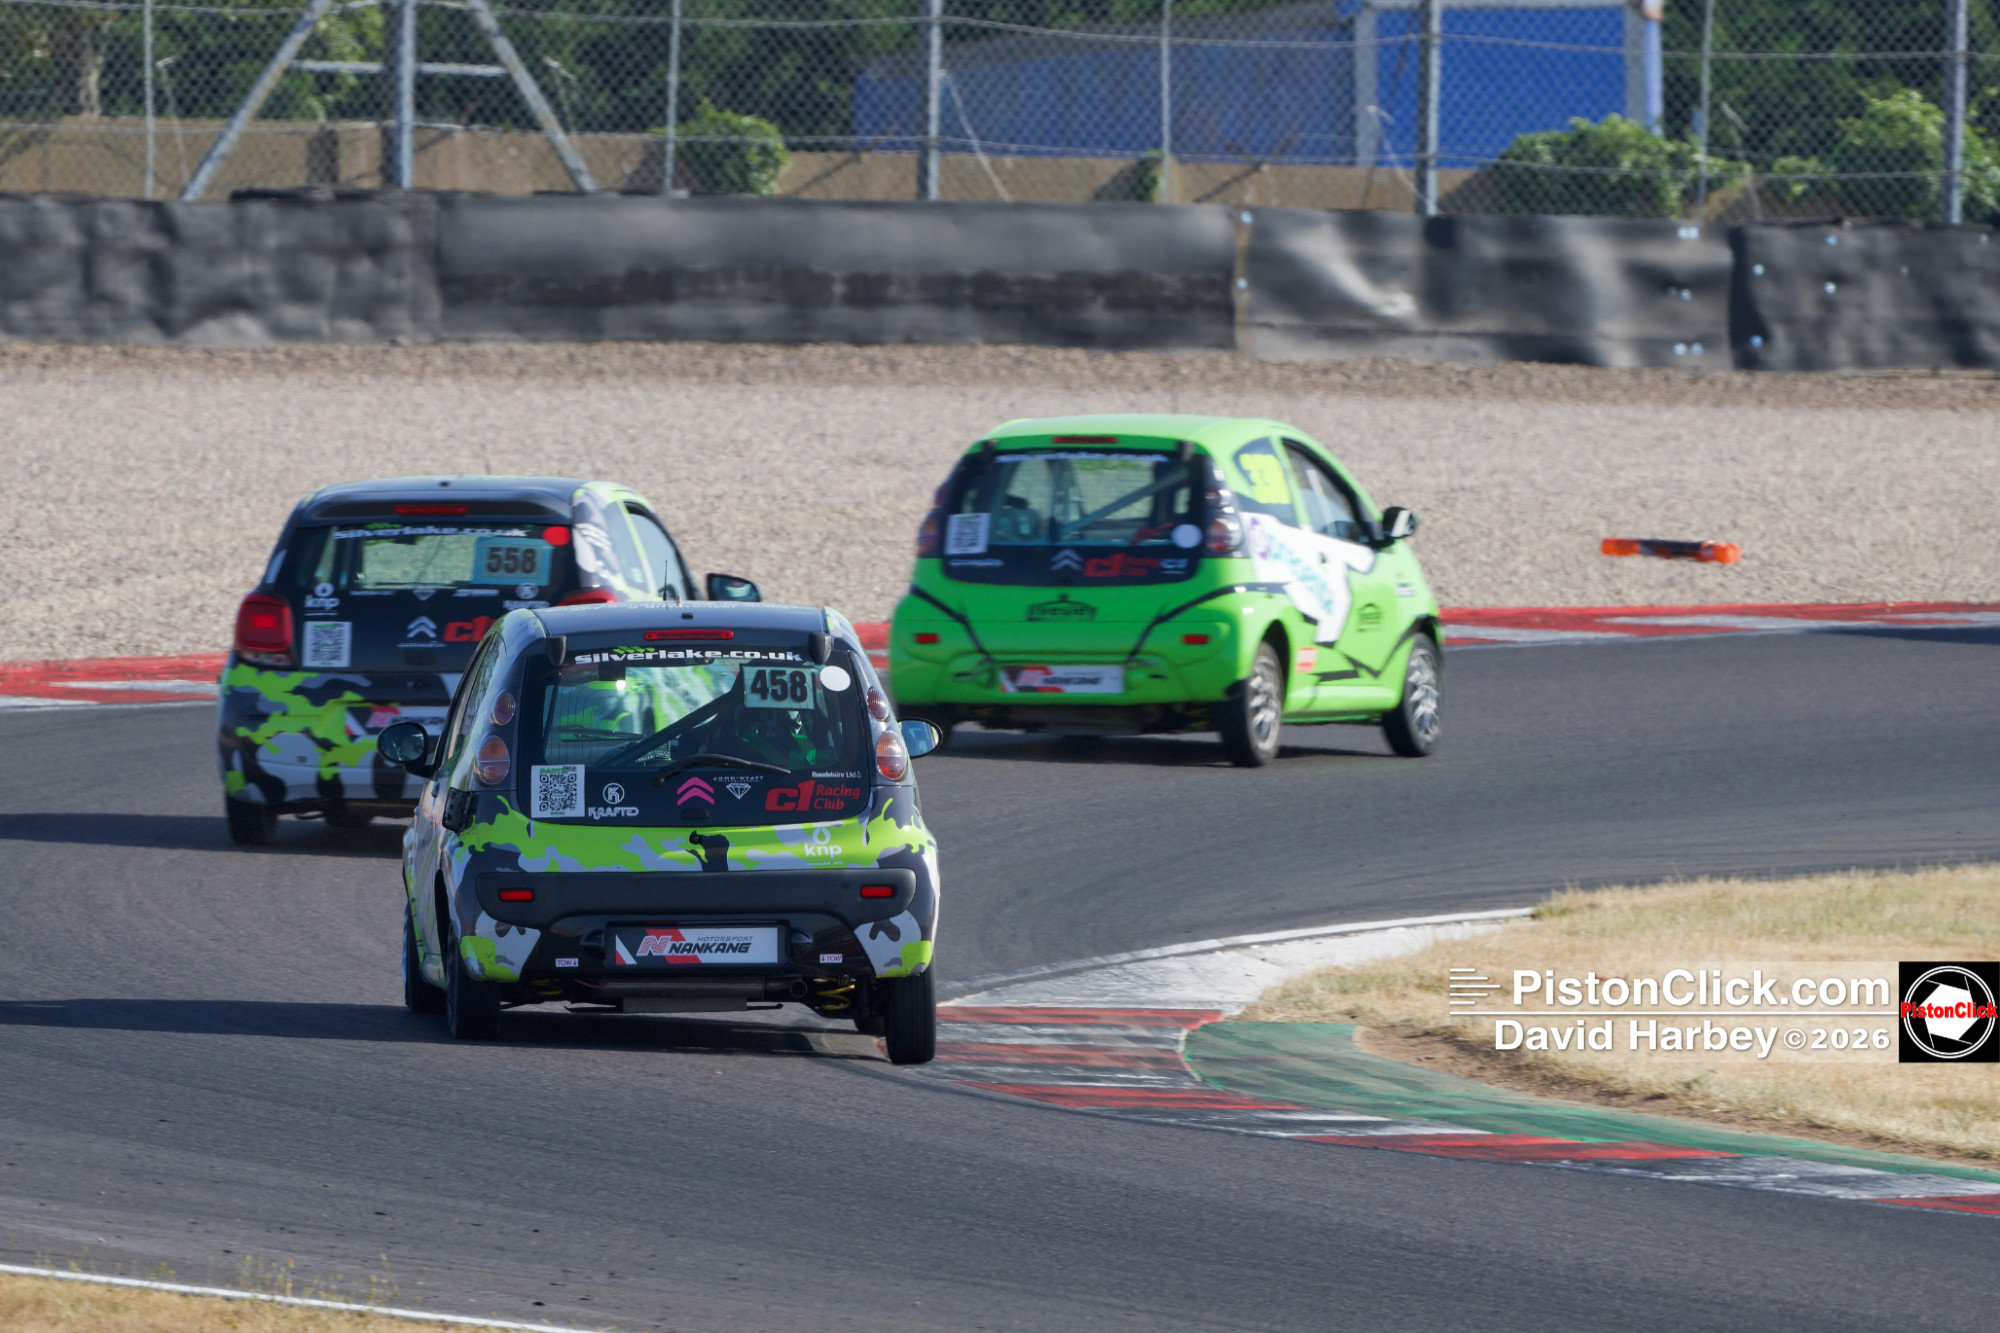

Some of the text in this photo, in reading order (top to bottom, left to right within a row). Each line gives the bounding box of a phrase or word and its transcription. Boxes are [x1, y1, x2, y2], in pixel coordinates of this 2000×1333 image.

[486, 547, 538, 574] 558
[751, 669, 808, 703] 458
[816, 784, 861, 799] Racing
[813, 798, 845, 810] Club
[804, 843, 842, 858] knp
[668, 942, 752, 954] NANKANG
